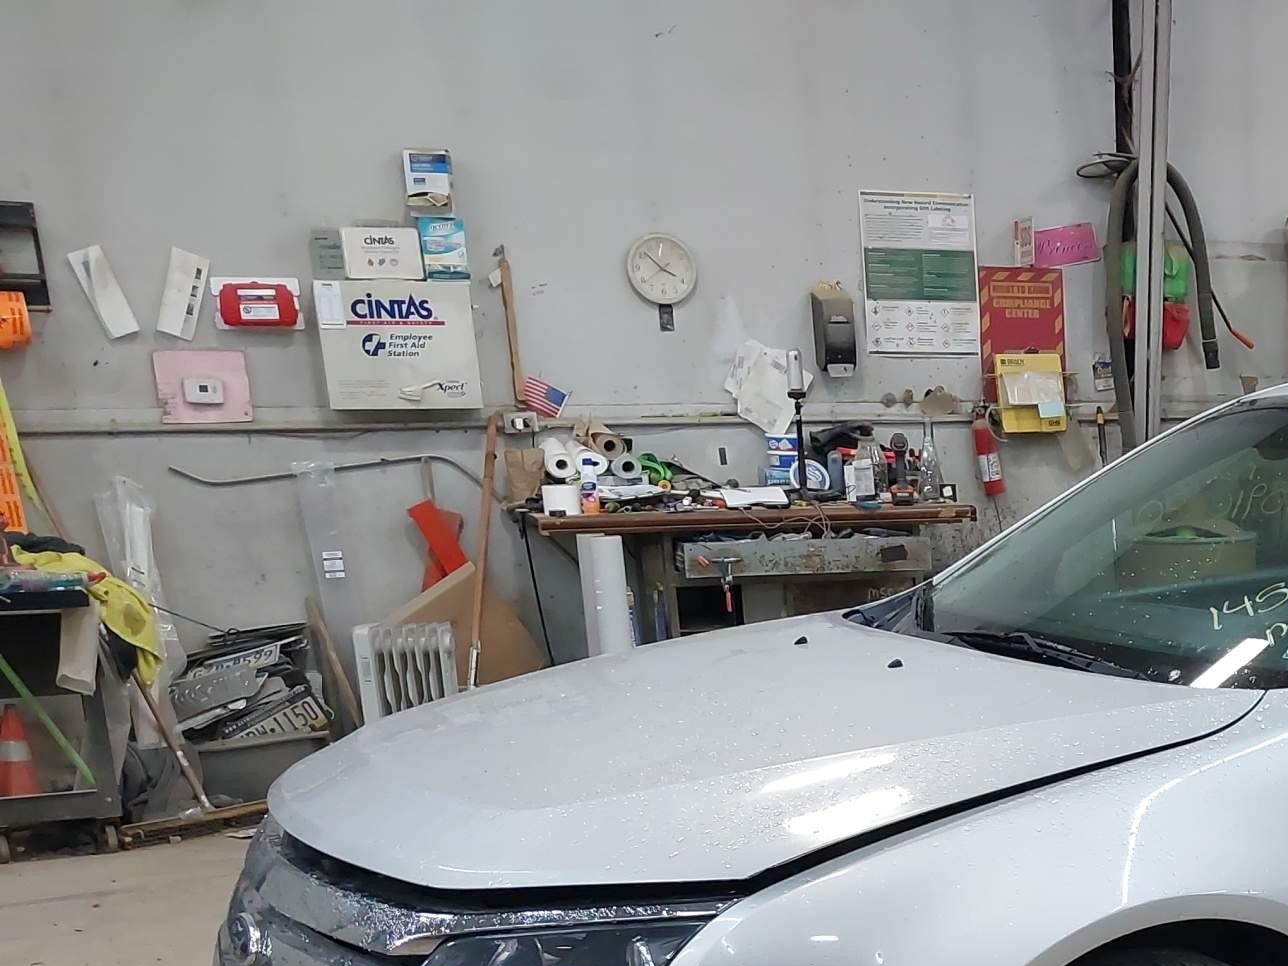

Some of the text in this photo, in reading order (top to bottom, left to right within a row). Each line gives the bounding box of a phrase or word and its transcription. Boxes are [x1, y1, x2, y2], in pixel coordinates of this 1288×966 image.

[389, 332, 434, 344] Employee
[388, 341, 426, 350] First Aid
[386, 350, 420, 358] Station
